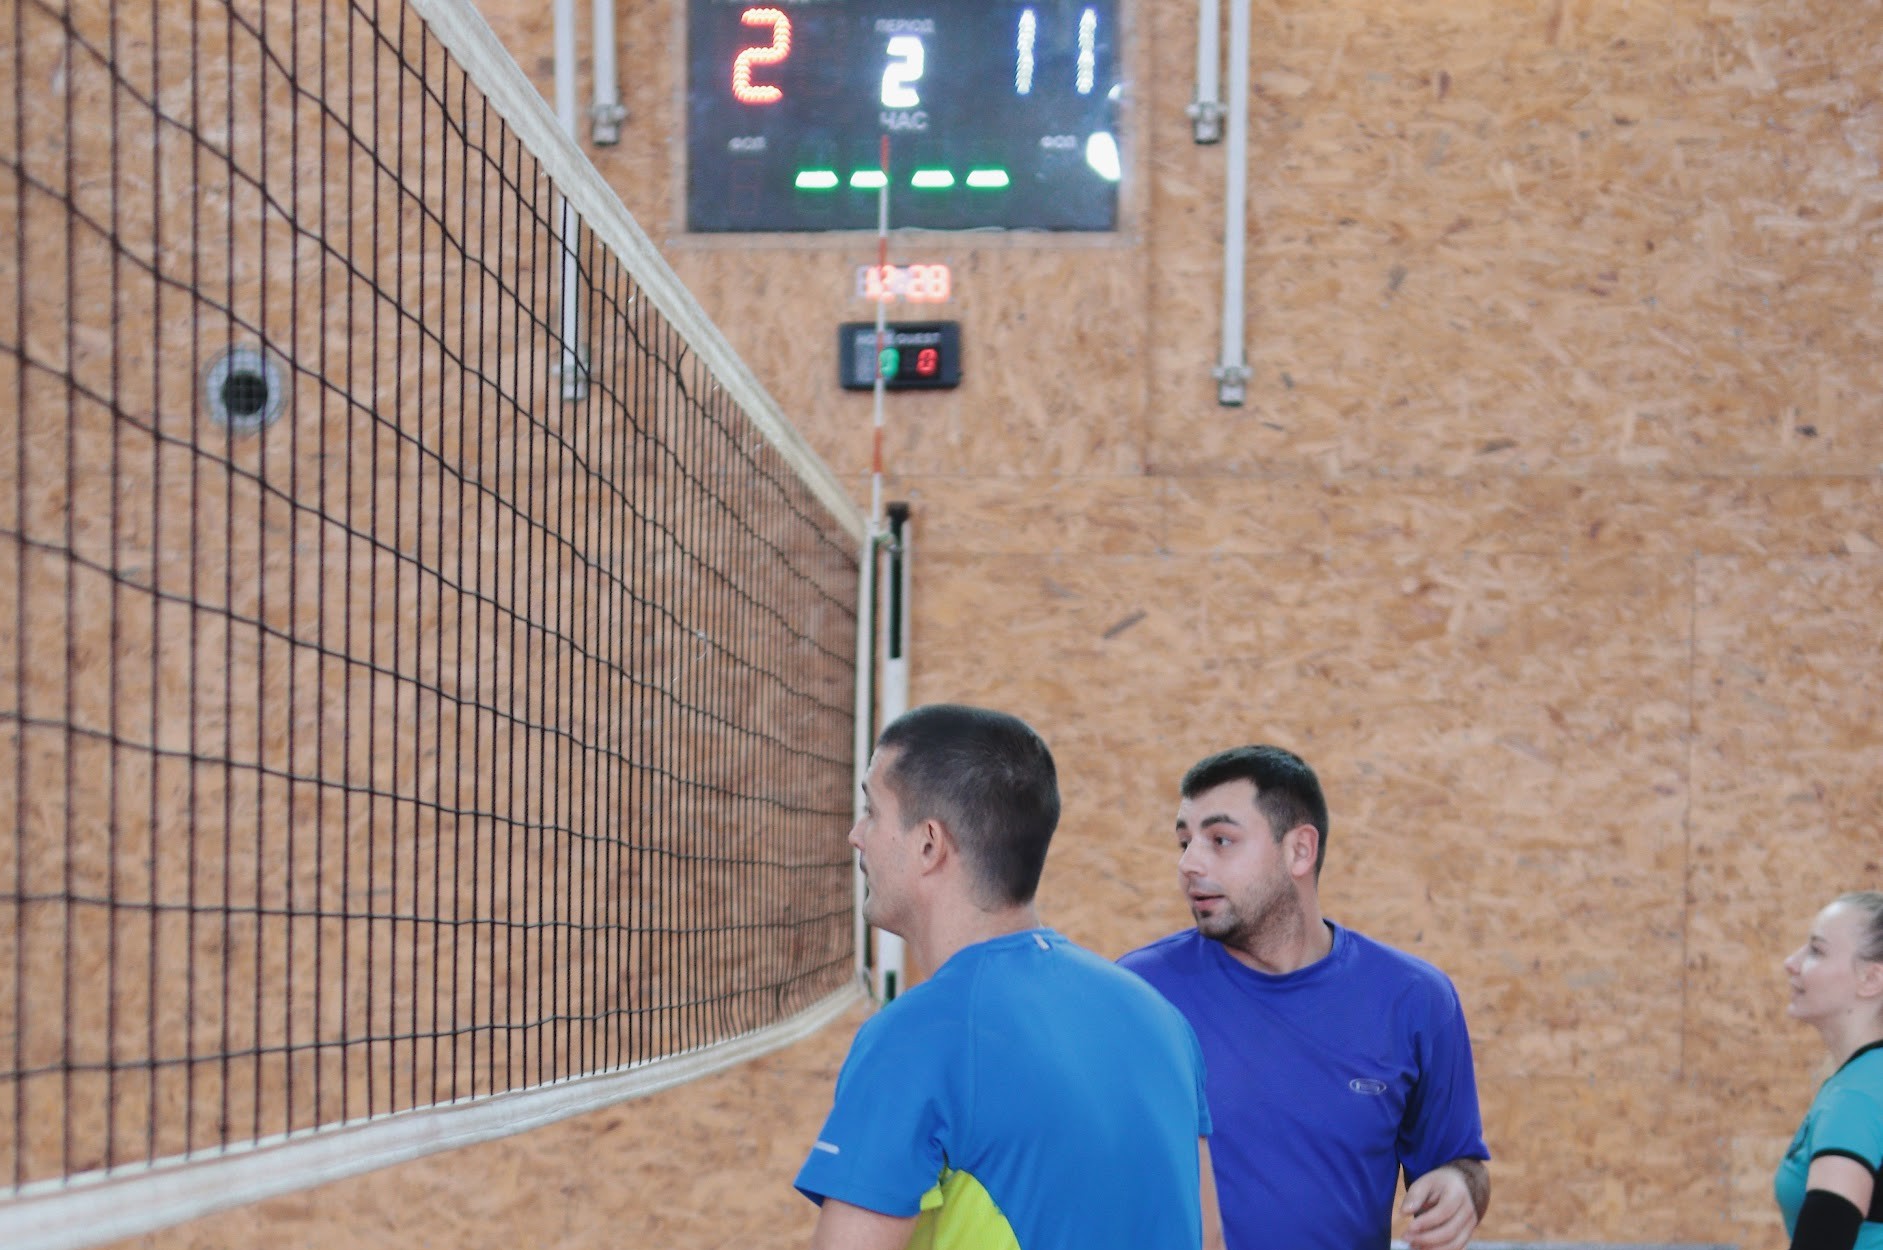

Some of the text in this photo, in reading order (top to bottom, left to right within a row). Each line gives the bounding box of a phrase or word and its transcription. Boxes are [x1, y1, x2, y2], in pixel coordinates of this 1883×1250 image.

[733, 7, 792, 105] 2
[881, 36, 925, 108] 2
[1014, 8, 1098, 95] 11
[880, 111, 928, 131] ЧАС
